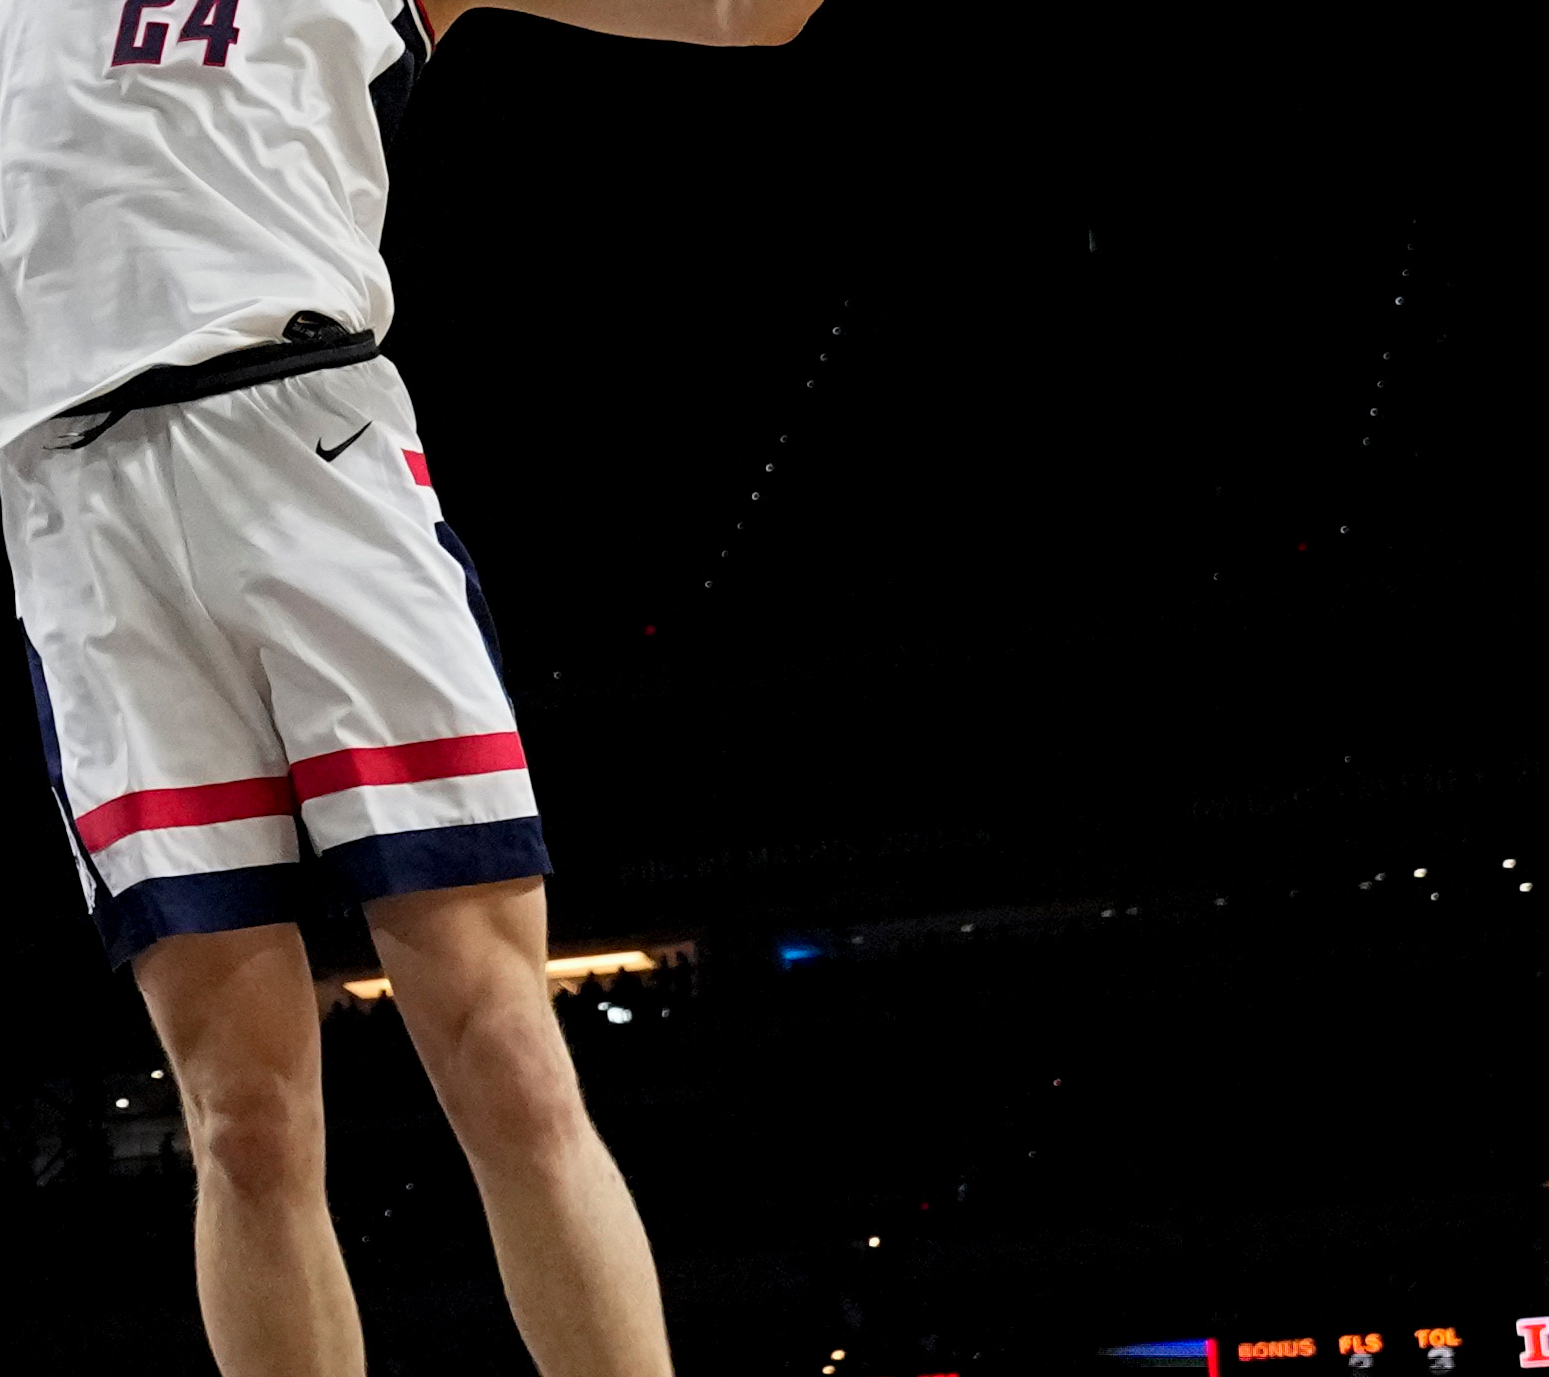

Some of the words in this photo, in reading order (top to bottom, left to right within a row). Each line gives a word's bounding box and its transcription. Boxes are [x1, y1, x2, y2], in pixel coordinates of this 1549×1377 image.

[1238, 1338, 1317, 1361] BONUS
[1338, 1332, 1384, 1354] FLS
[1414, 1327, 1463, 1348] TOL
